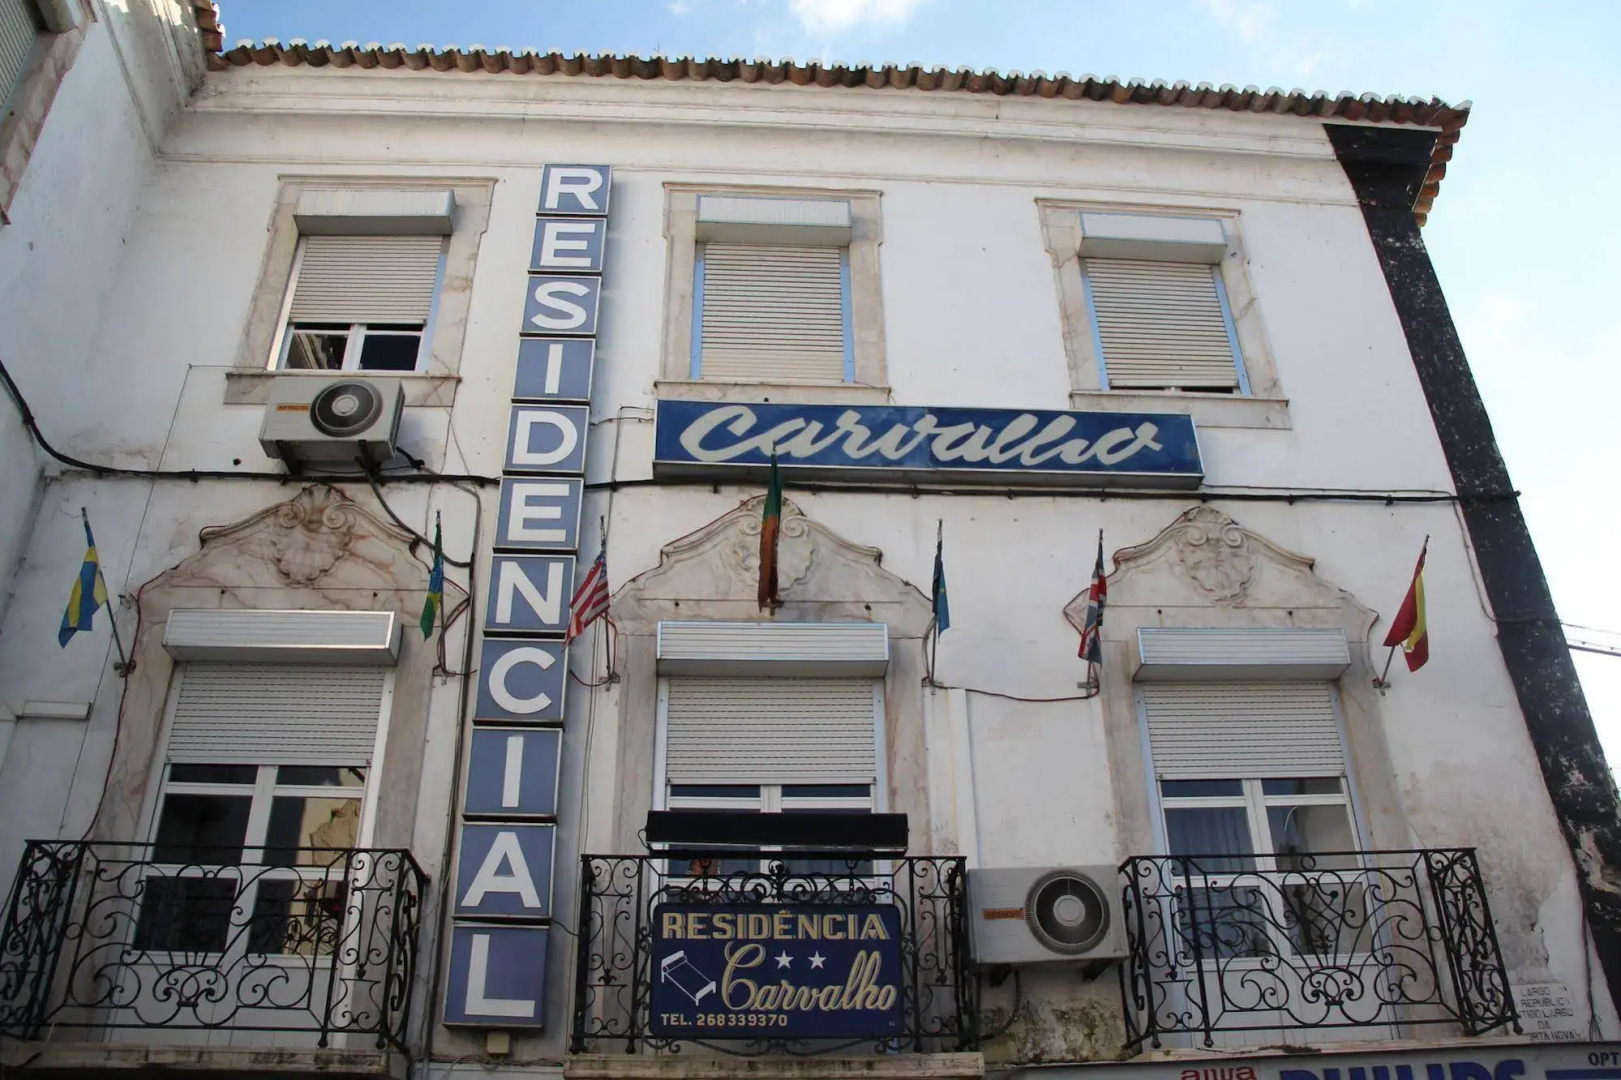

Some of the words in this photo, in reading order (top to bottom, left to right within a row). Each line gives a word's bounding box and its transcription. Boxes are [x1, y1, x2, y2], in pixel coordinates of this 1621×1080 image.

[679, 405, 1163, 467] Carvalho
[460, 167, 603, 1018] RESIDENCIAL
[661, 909, 891, 941] RESIDÊNCIA
[721, 941, 898, 1012] Carvalho
[661, 1013, 692, 1026] TEL.
[697, 1013, 788, 1027] 268339370
